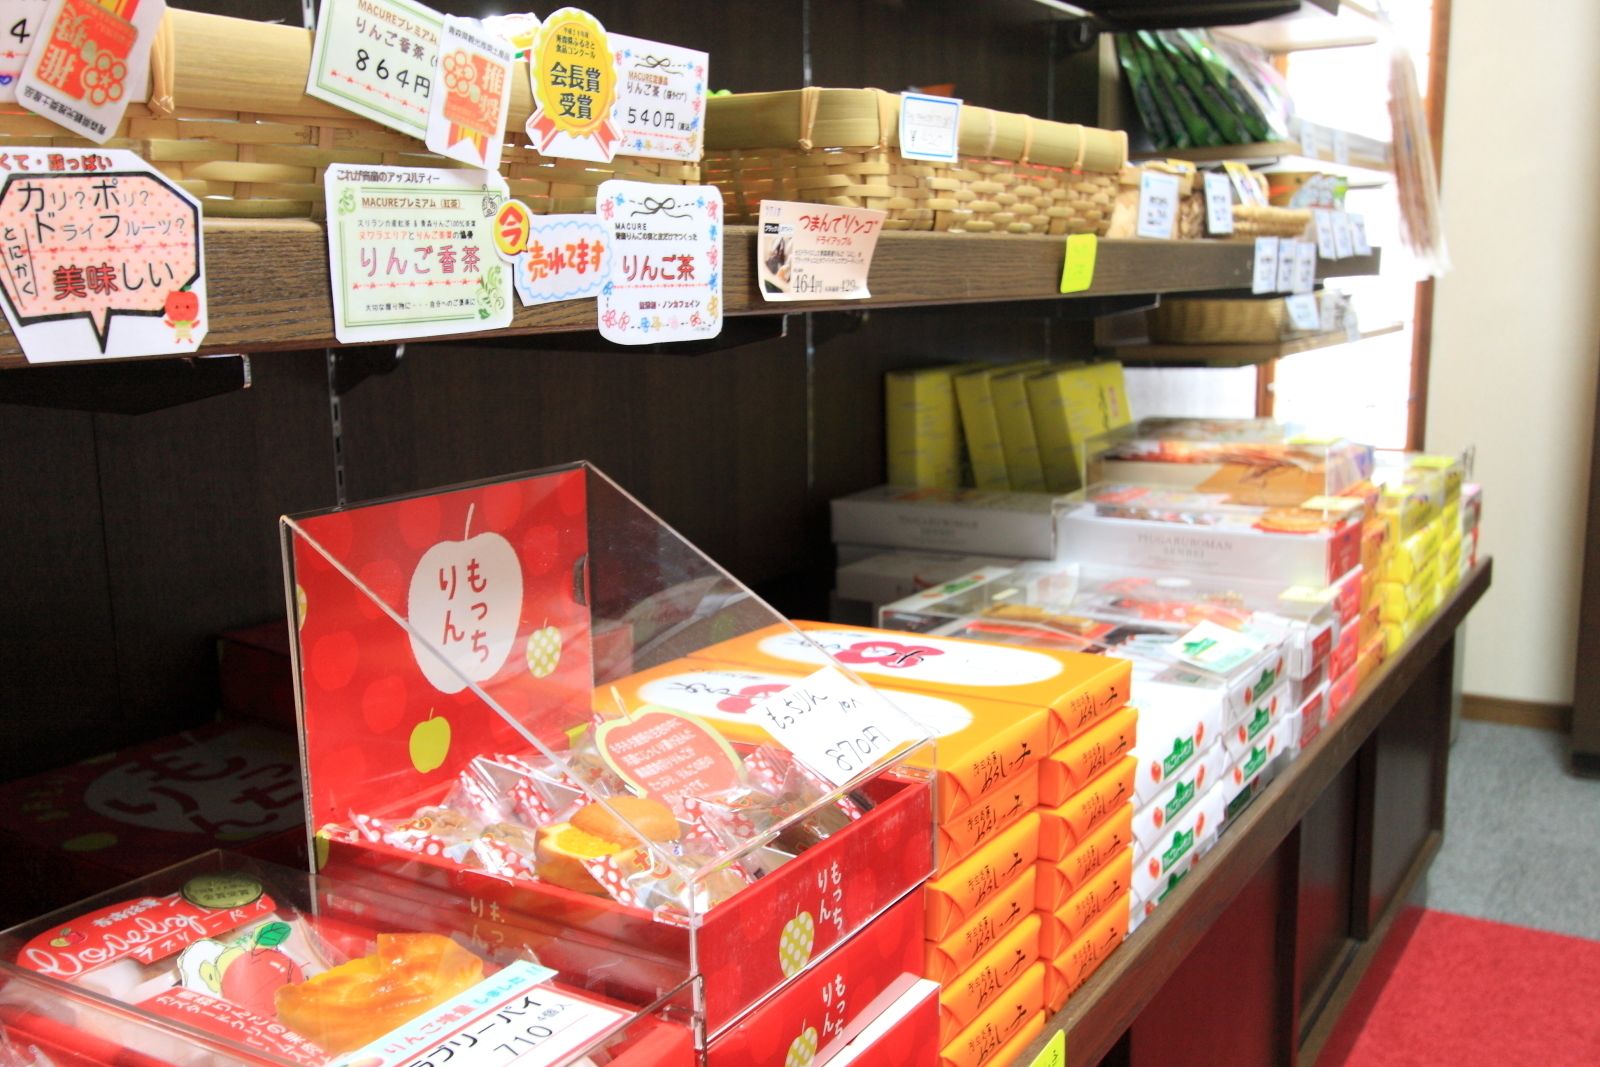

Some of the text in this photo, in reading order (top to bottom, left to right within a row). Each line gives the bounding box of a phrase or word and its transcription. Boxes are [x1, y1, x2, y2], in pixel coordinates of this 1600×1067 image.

[356, 16, 425, 62] りんご香茶
[355, 48, 431, 99] 864円
[550, 61, 602, 94] 会長賞
[559, 92, 593, 121] 受賞
[627, 106, 676, 130] 540円
[499, 205, 524, 248] 今
[614, 222, 648, 232] MACURE
[3, 225, 36, 296] とにかく
[53, 261, 174, 300] 美味しい
[359, 244, 481, 278] りんご香茶
[527, 238, 605, 283] 売れてます
[622, 253, 696, 282] りんご茶
[438, 565, 465, 646] りん
[466, 558, 491, 663] もっち
[817, 868, 832, 924] りん
[831, 860, 843, 930] もっち
[821, 981, 835, 1036] りん
[835, 973, 846, 1040] もっち
[493, 1024, 553, 1057] 710
